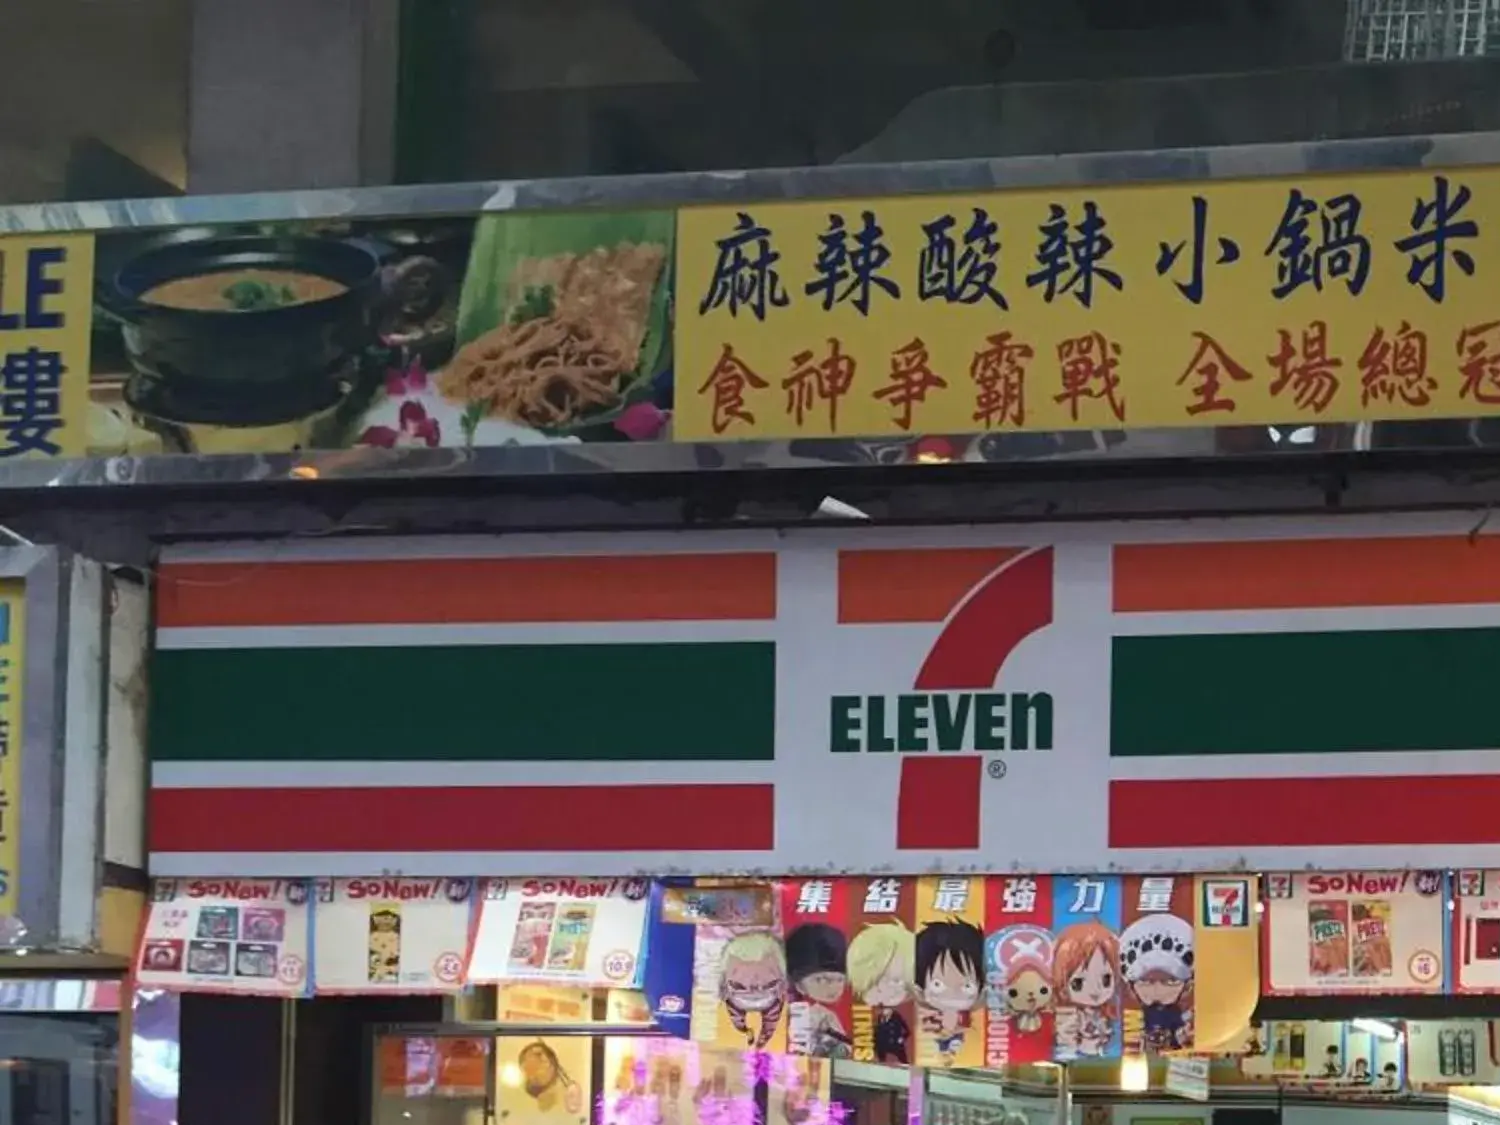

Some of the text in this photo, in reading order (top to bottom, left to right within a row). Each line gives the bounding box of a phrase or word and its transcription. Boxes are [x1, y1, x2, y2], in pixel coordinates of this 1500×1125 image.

[698, 331, 1126, 434] 食神爭霸戰
[896, 545, 1053, 849] 7
[797, 876, 1174, 913] 集結最強力量
